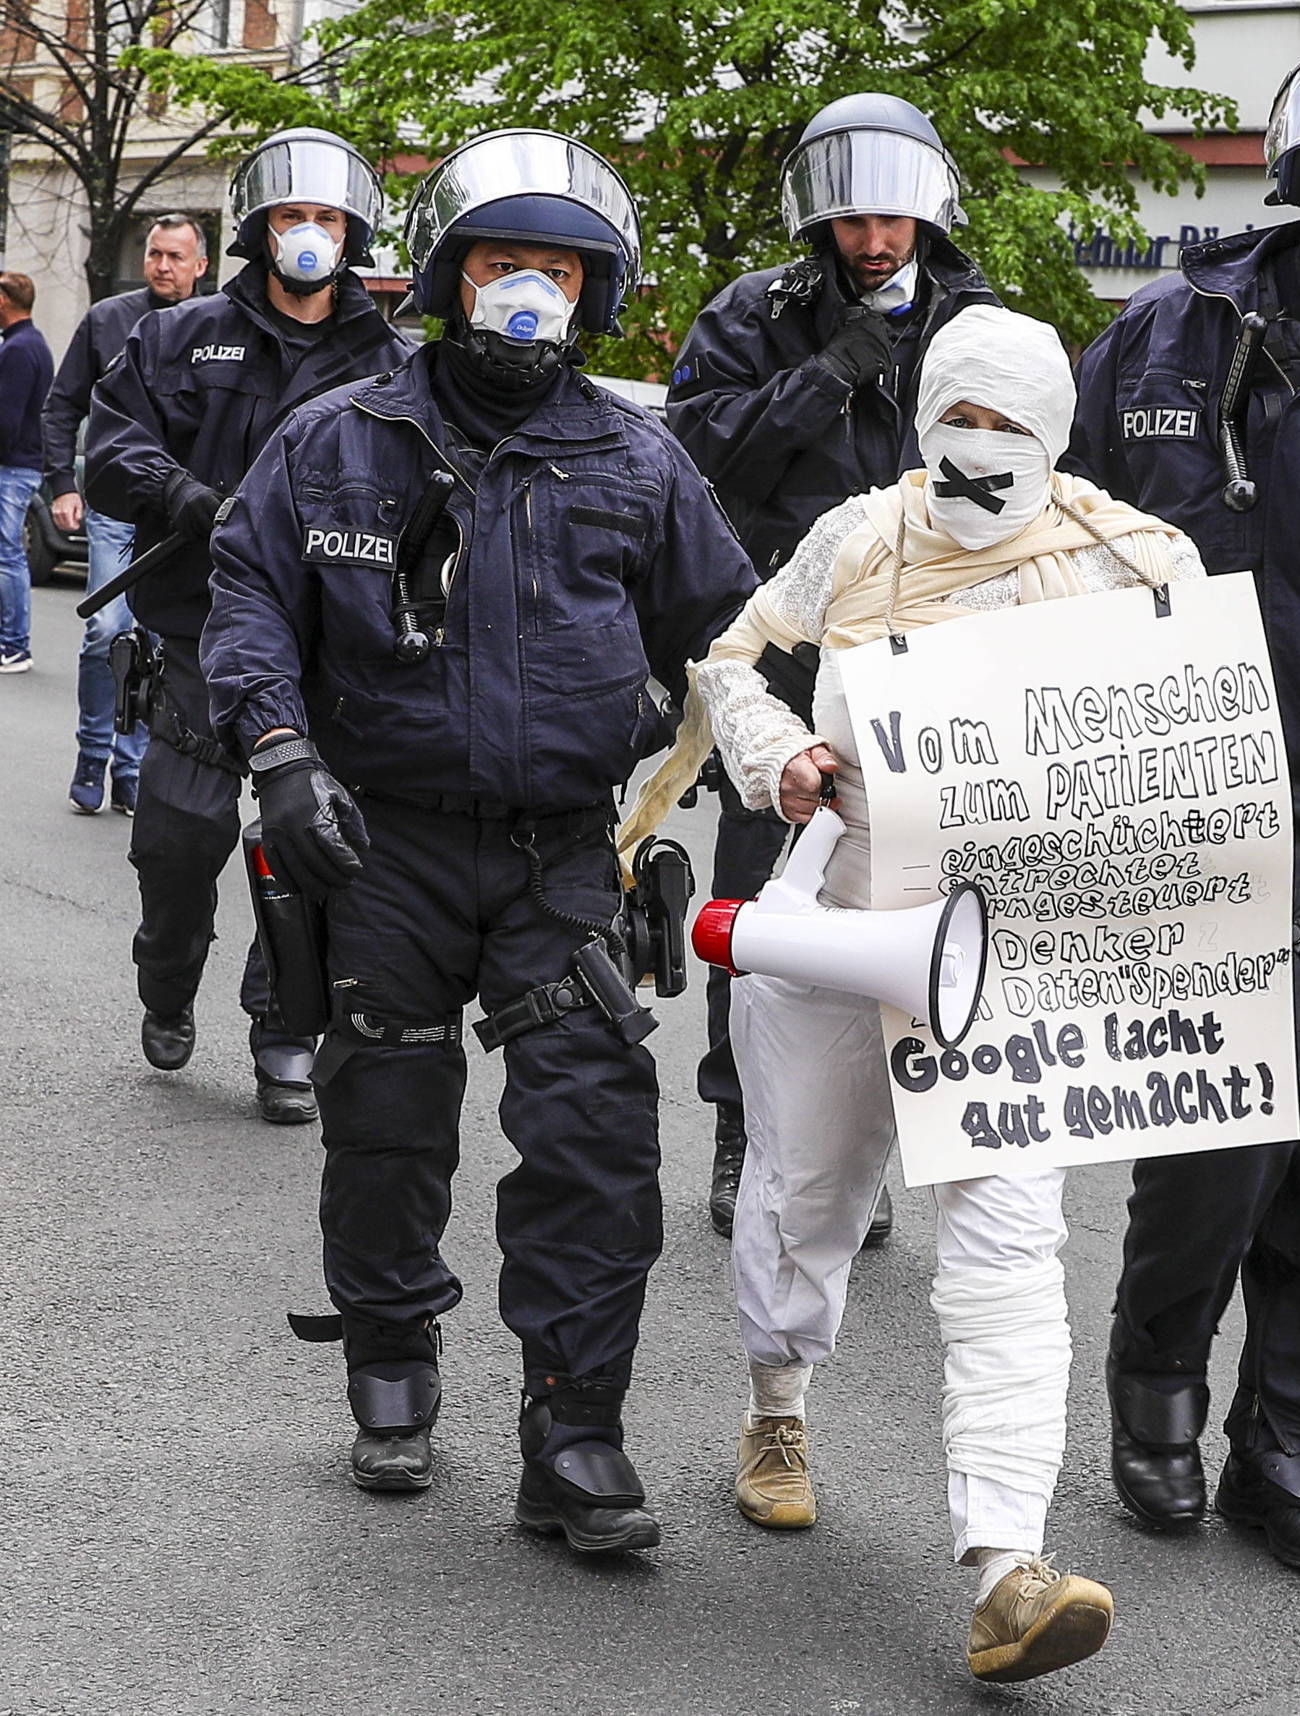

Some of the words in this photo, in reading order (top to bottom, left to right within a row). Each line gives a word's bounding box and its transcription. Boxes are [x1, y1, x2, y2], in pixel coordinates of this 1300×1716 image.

[191, 344, 245, 363] POLIZEI
[1123, 409, 1197, 438] POLIZEI
[306, 529, 393, 563] POLIZEI
[870, 710, 999, 774] Vom
[1025, 662, 1270, 756] Menschen
[940, 777, 1031, 829] zum
[941, 801, 1280, 875] eingeschüchtert
[938, 852, 1200, 897] entrechtet
[986, 872, 1251, 922] rngesteuert
[991, 921, 1184, 970] Denker
[890, 1019, 1086, 1093] Google
[1104, 1009, 1225, 1062] lacht
[960, 1093, 1050, 1149] gut
[1063, 1062, 1275, 1140] gemacht!
